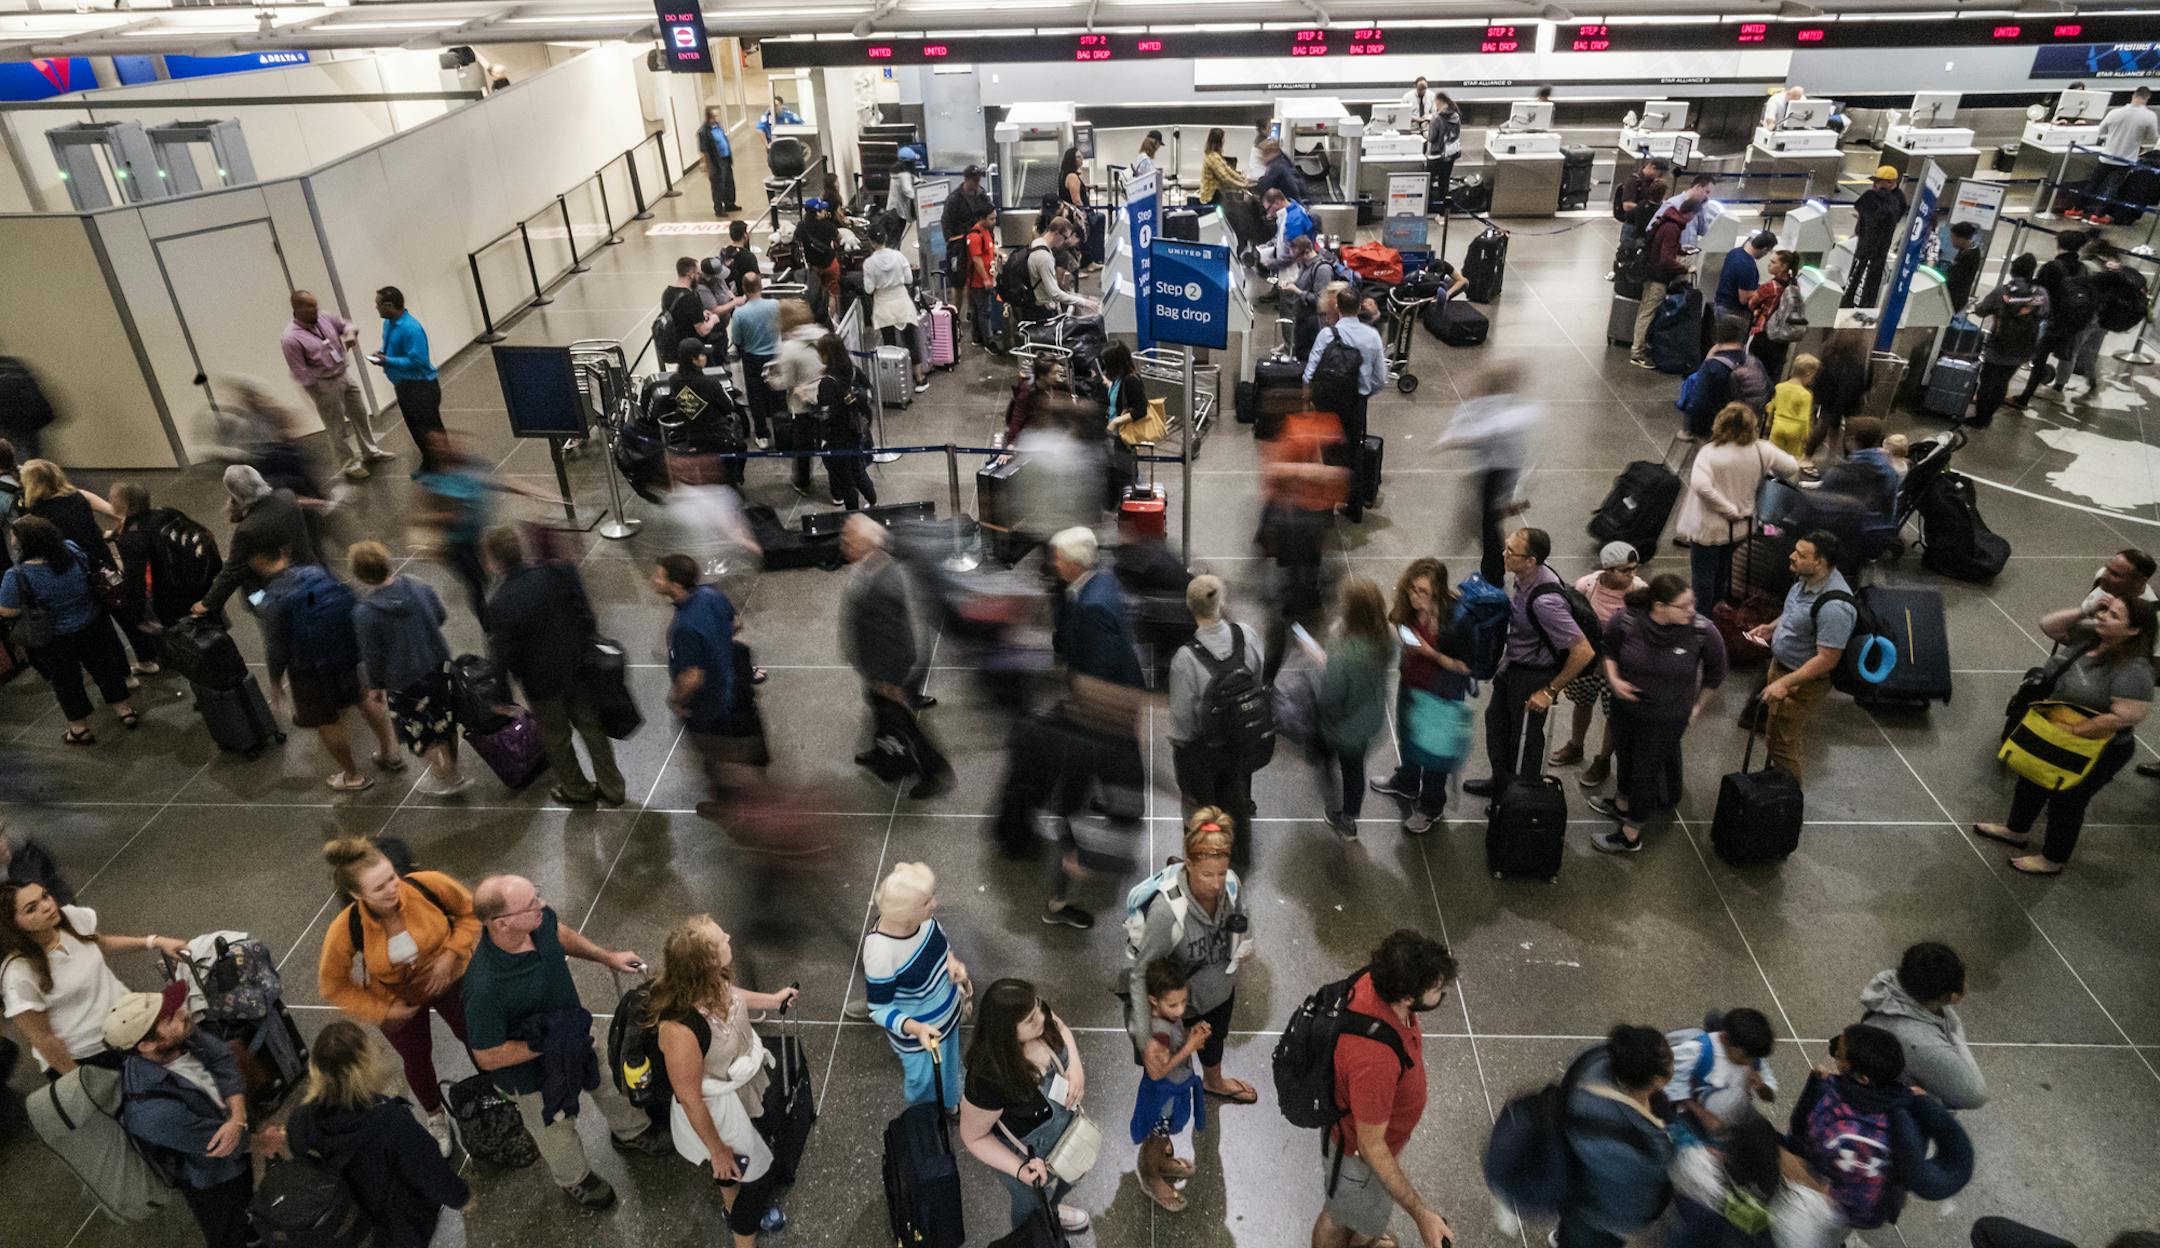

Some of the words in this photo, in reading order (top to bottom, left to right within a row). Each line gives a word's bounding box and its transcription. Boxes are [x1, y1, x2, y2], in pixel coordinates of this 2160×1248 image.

[664, 13, 677, 22] DO
[678, 12, 694, 21] NOT
[1487, 27, 1506, 37] STEP
[1507, 27, 1515, 36] 2
[1580, 26, 1599, 36] STEP
[1600, 26, 1607, 36] 2
[1741, 24, 1766, 33] UNITED
[1993, 27, 2020, 37] UNITED
[2054, 25, 2081, 36] UNITED
[1297, 31, 1316, 41] STEP
[1317, 30, 1324, 40] 2
[1354, 30, 1373, 40] STEP
[1374, 29, 1382, 39] 2
[1797, 31, 1824, 40] UNITED
[1080, 35, 1098, 45] STEP
[1100, 35, 1106, 45] 2
[924, 46, 948, 56] UNITED
[1138, 41, 1162, 51] UNITED
[1292, 46, 1307, 56] BAG
[1309, 46, 1328, 55] DROP
[1349, 45, 1364, 54] BAG
[1366, 44, 1385, 54] DROP
[1481, 42, 1497, 52] BAG
[1499, 42, 1518, 51] DROP
[1573, 41, 1588, 51] BAG
[1590, 41, 1609, 50] DROP
[677, 52, 700, 60] ENTER
[868, 47, 892, 57] UNITED
[1076, 50, 1091, 60] BAG
[1093, 50, 1111, 59] DROP
[267, 53, 298, 62] DELTA
[1137, 209, 1152, 224] Step
[1168, 247, 1201, 257] UNITED
[1156, 281, 1183, 297] Step
[1156, 304, 1180, 320] Bag
[1182, 306, 1211, 324] drop
